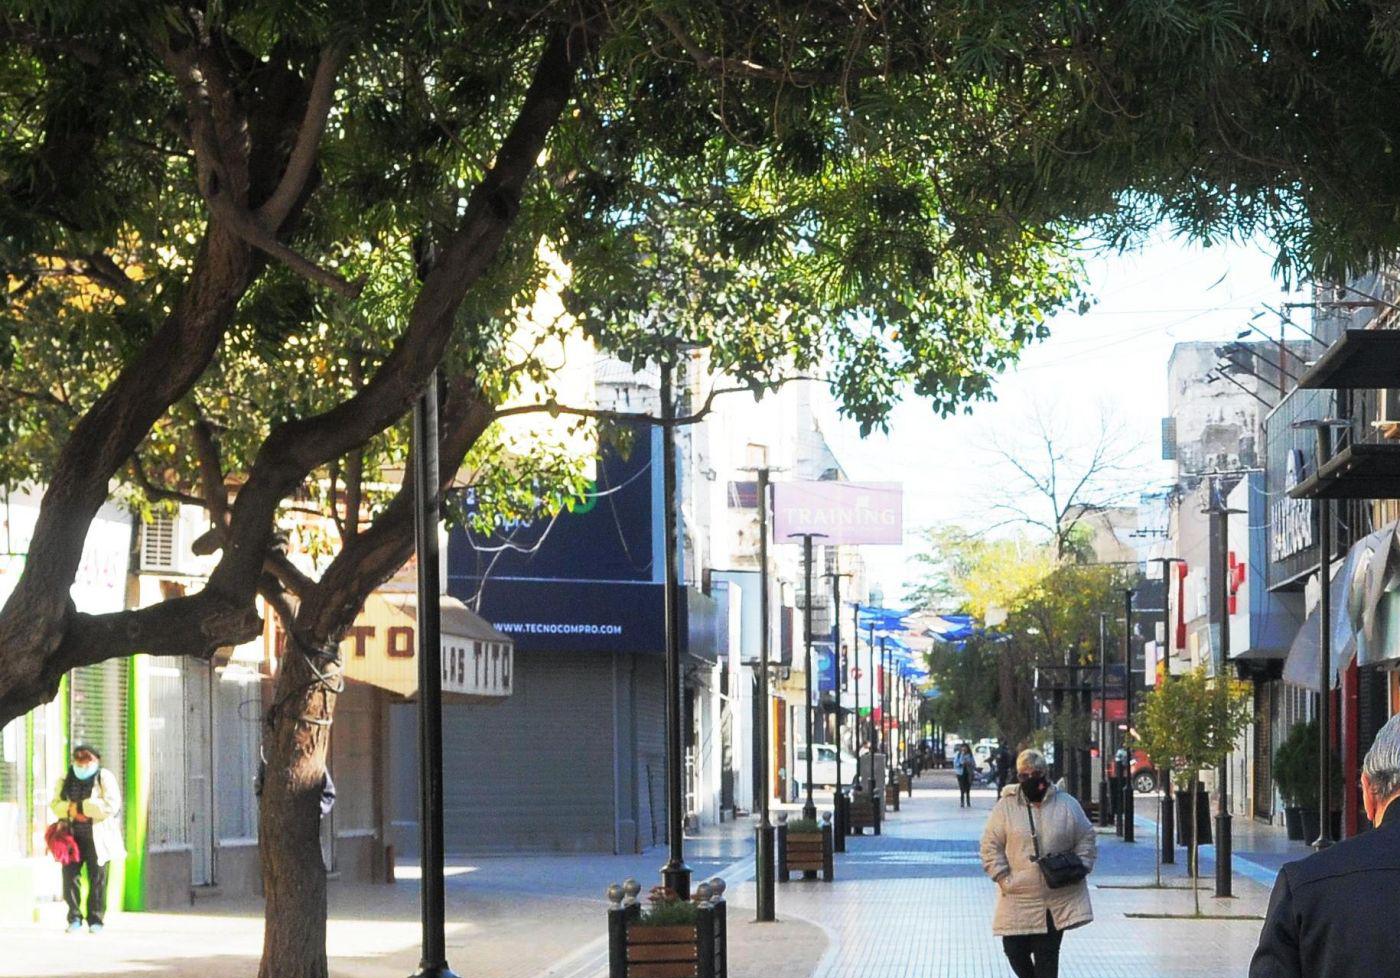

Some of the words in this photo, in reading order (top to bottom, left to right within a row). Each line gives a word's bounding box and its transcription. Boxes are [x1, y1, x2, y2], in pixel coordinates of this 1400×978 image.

[784, 508, 896, 526] TRAINING
[493, 622, 622, 635] WWW.TECNOCOMPRO.COM
[473, 640, 511, 687] TITO
